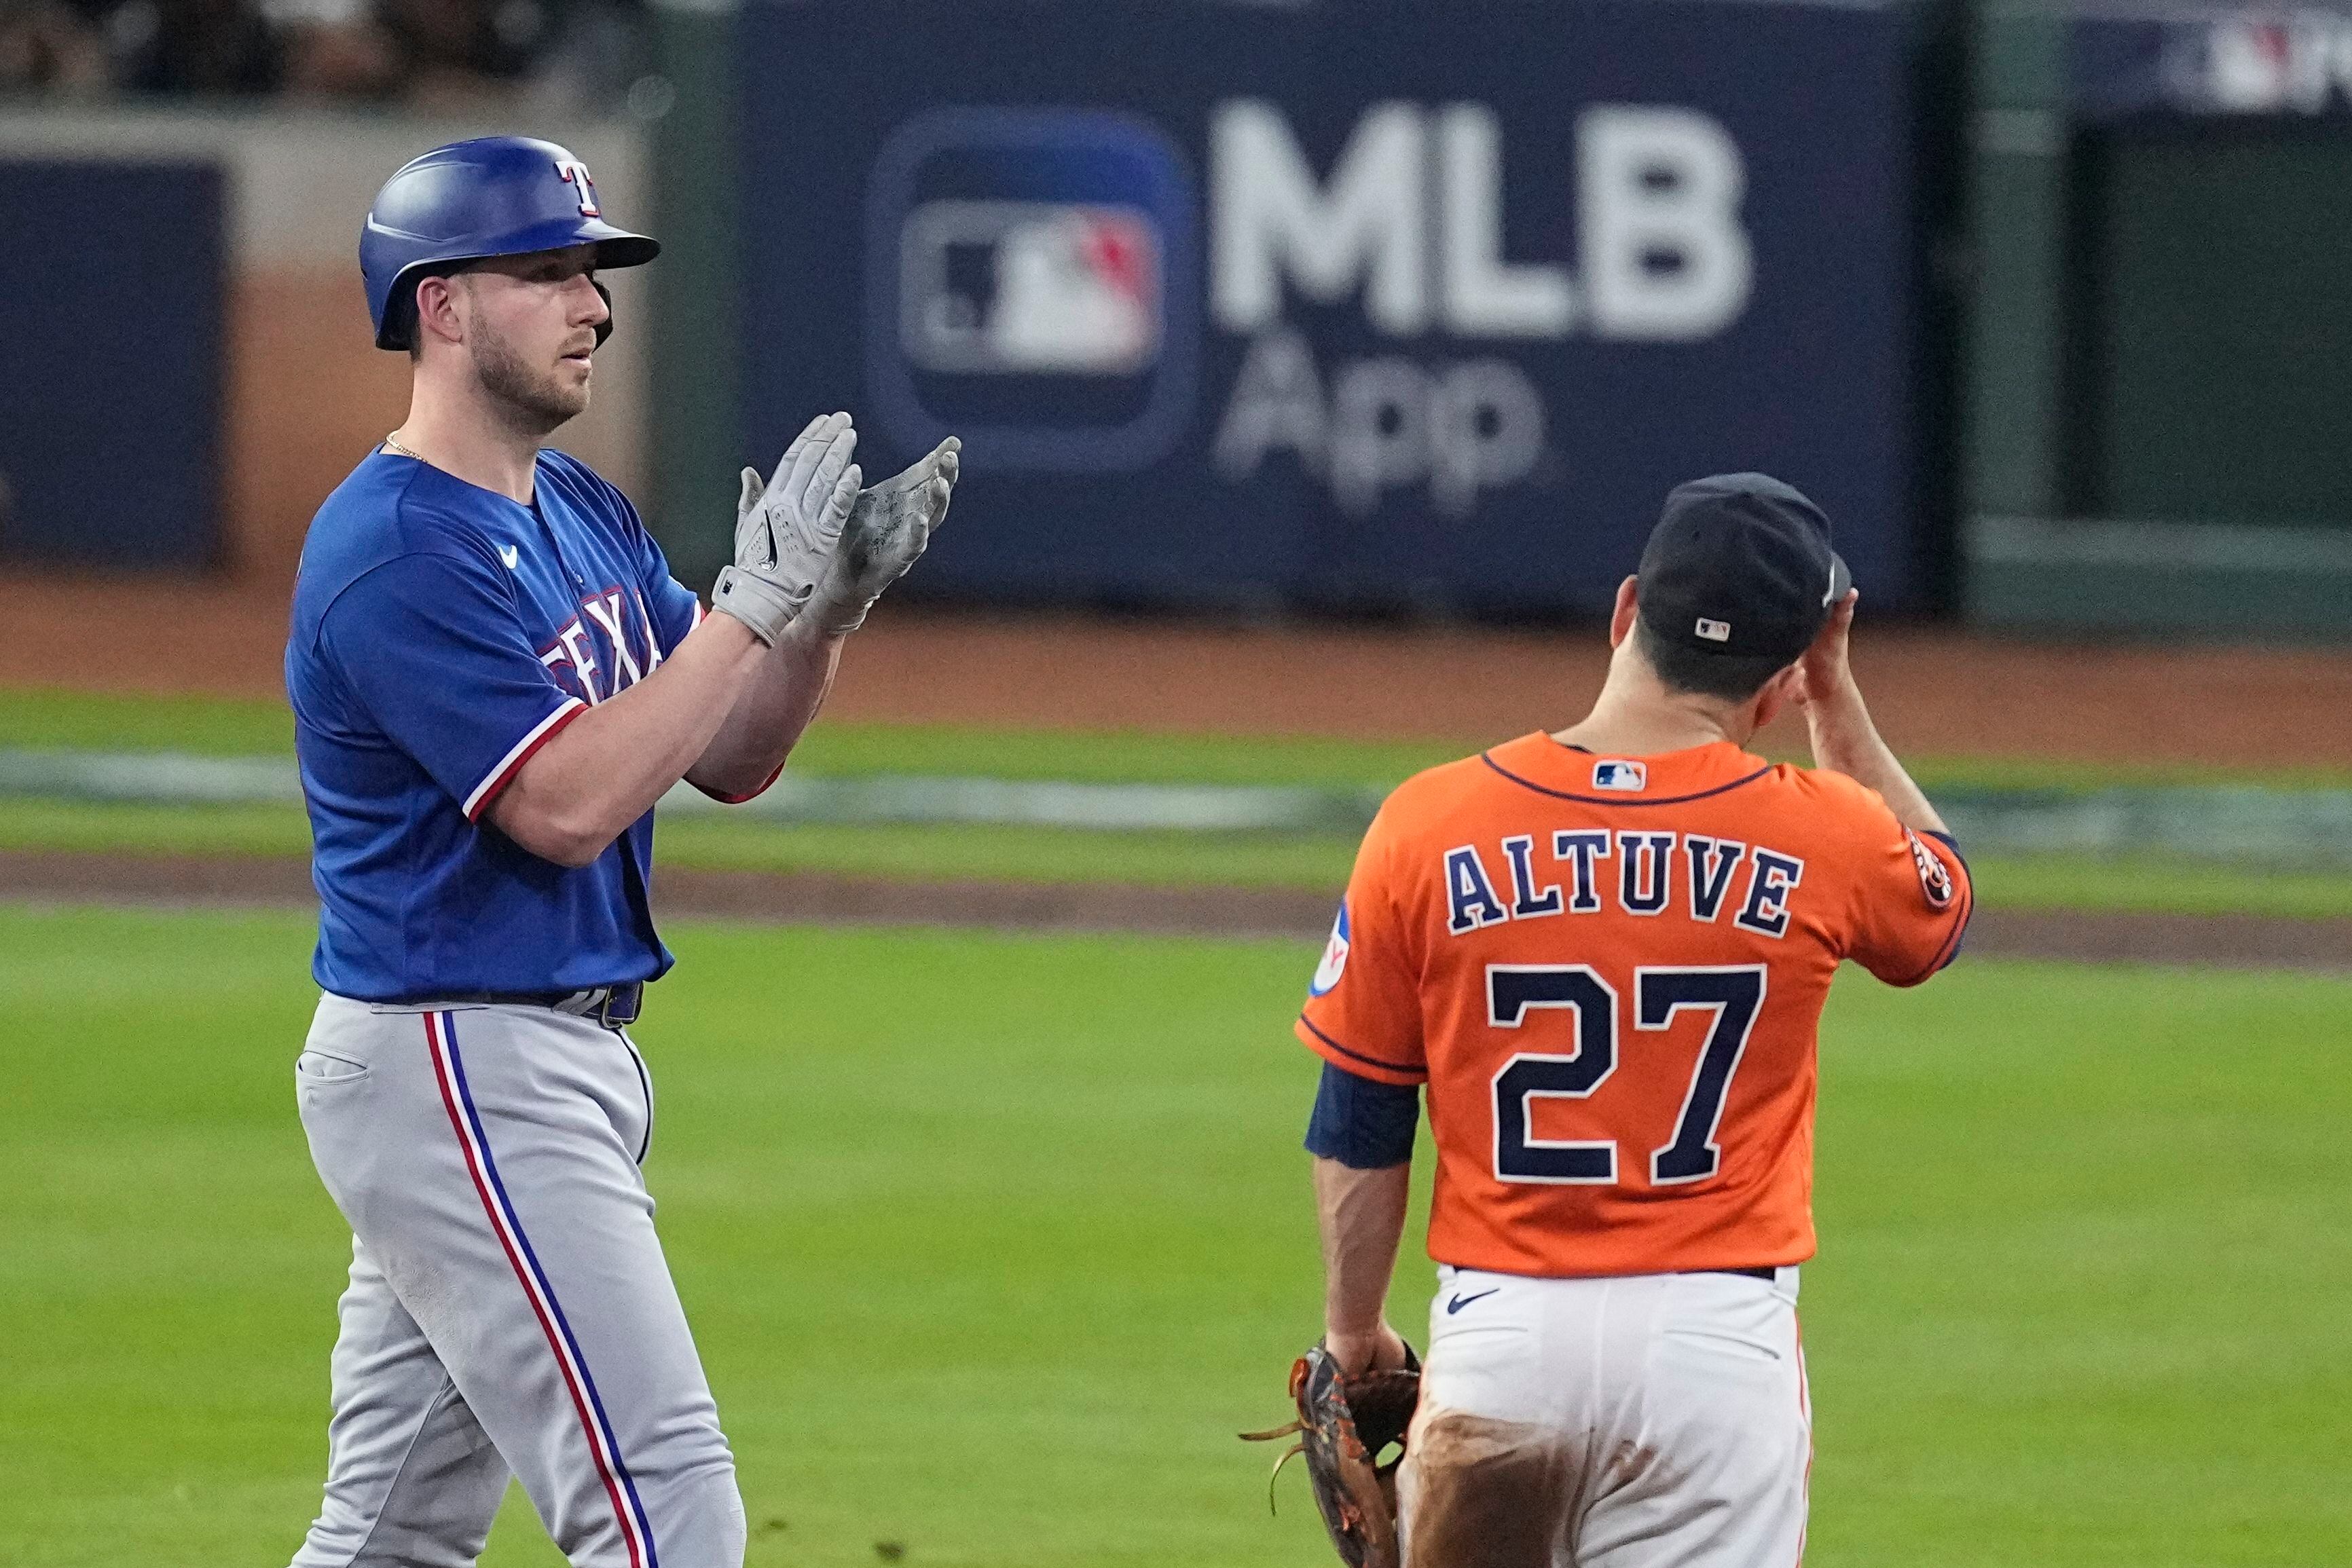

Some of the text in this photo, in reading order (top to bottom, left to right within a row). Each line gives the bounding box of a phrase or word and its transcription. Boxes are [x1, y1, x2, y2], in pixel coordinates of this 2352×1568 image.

[554, 161, 600, 217] T
[1212, 100, 1752, 337] MLB
[1220, 329, 1547, 509] App
[1444, 829, 1803, 937] ALTUVE
[1486, 965, 1766, 1184] 27
